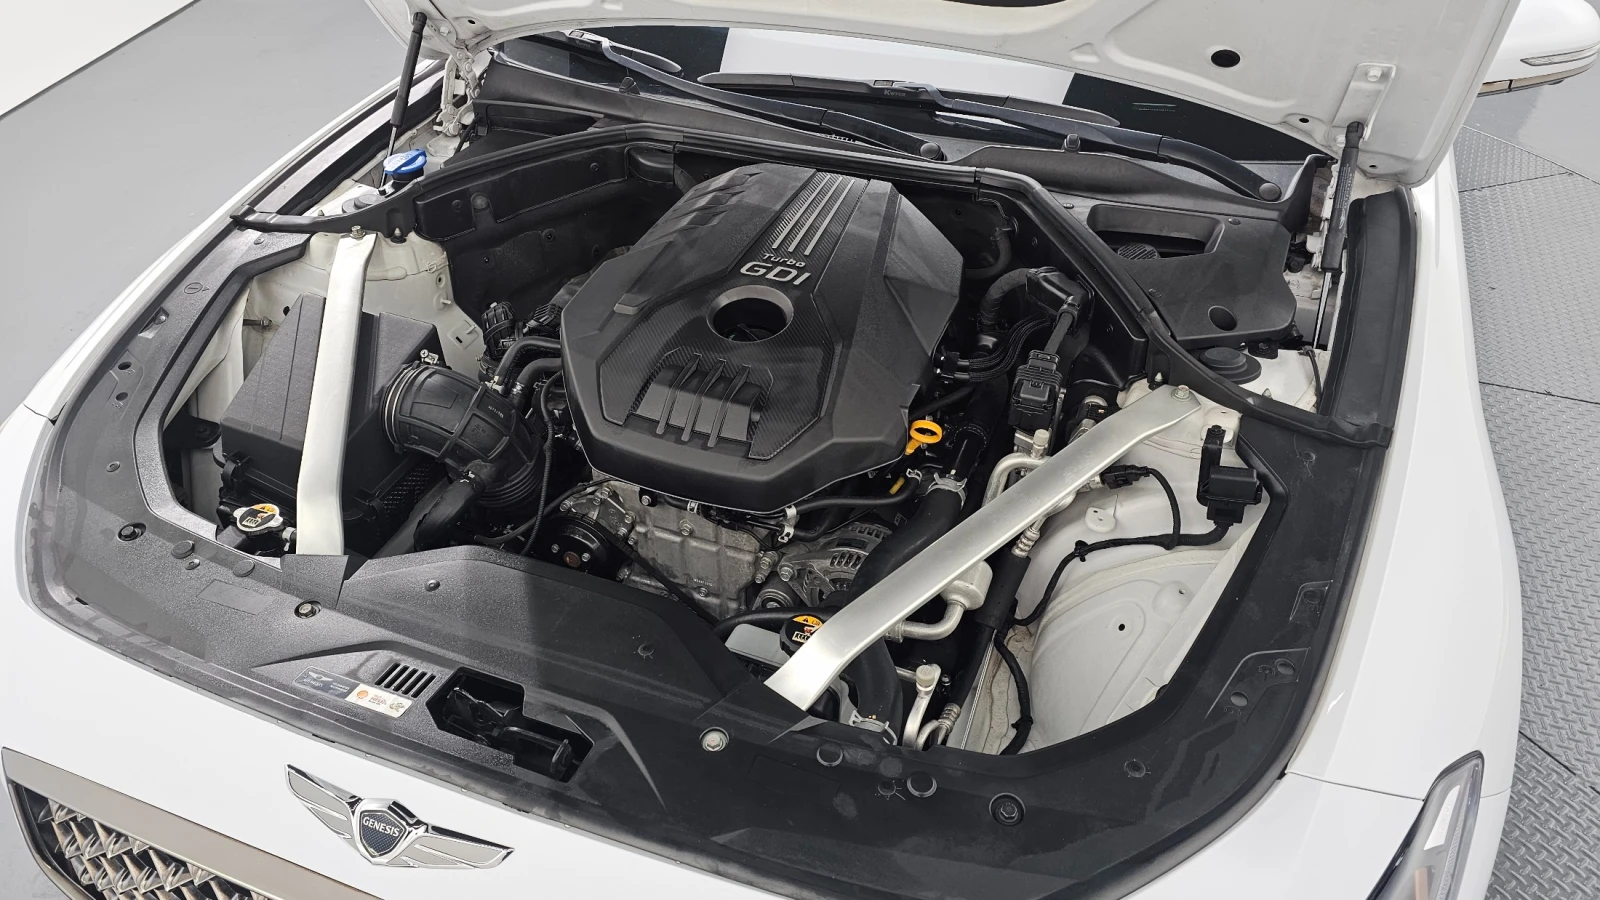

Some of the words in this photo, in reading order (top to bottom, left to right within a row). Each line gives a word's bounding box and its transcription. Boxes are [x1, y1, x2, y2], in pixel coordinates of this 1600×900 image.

[762, 252, 806, 267] Turbo
[740, 261, 811, 285] GDI
[363, 816, 400, 837] GENESIS
